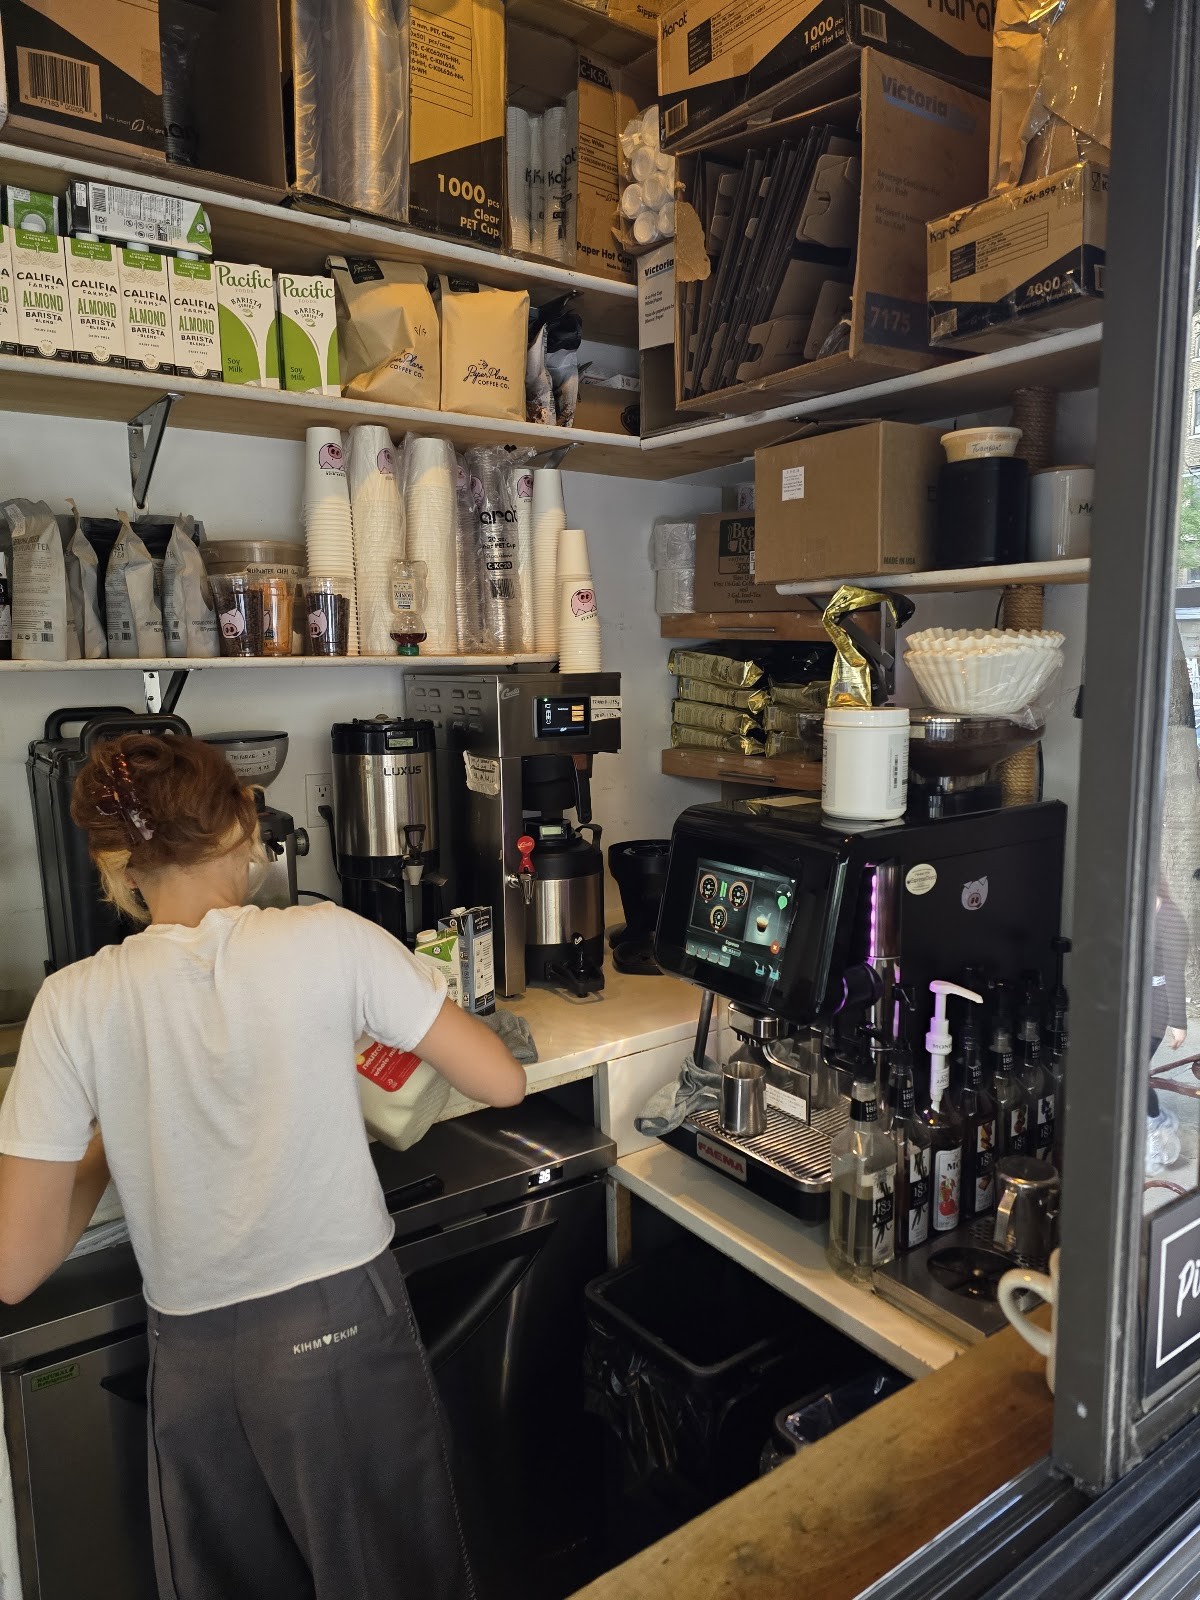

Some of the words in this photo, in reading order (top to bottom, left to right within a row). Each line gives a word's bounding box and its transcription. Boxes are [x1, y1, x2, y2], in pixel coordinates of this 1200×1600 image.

[662, 11, 687, 40] Karat
[804, 16, 833, 45] 1000
[834, 16, 845, 28] pcs
[441, 31, 455, 41] Clear
[809, 41, 822, 54] PET
[822, 35, 834, 47] Flat
[580, 63, 611, 87] C-K50
[881, 73, 948, 118] Victoria
[40, 97, 60, 108] 77183
[64, 103, 84, 115] 00205
[438, 173, 485, 204] 1000
[487, 198, 499, 209] pcs
[474, 208, 499, 225] Clear
[460, 216, 478, 231] PET
[480, 222, 499, 239] Cup
[577, 241, 600, 256] Paper
[601, 248, 615, 261] Hot
[617, 253, 632, 267] Cup
[645, 258, 674, 277] Victoria
[17, 272, 64, 287] CALIFIA
[215, 265, 273, 289] Pacific
[72, 280, 118, 294] CALIFIA
[279, 277, 336, 299] Pacific
[23, 290, 64, 312] ALMOND
[123, 289, 167, 303] CALIFIA
[231, 296, 262, 309] BARISTA
[78, 297, 117, 318] ALMOND
[174, 298, 215, 312] CALIFIA
[294, 307, 324, 319] BARISTA
[26, 311, 63, 322] BARISTA
[80, 318, 117, 329] BARISTA
[129, 307, 166, 327] ALMOND
[871, 305, 911, 336] 7175
[131, 326, 165, 337] BARISTA
[179, 316, 214, 335] ALMOND
[181, 334, 214, 344] BARISTA
[227, 358, 240, 366] Soy
[228, 365, 243, 374] Milk
[291, 367, 303, 375] Soy
[291, 374, 305, 382] Milk
[389, 363, 412, 375] COFFEE
[413, 371, 424, 379] CO.
[463, 365, 488, 384] Paper
[488, 367, 509, 381] Plane
[477, 379, 499, 388] COFFEE
[480, 505, 518, 524] arat
[37, 543, 50, 551] TEA
[884, 557, 898, 565] MADE
[905, 557, 916, 565] USA
[384, 766, 422, 776] LUXUS
[374, 1057, 390, 1077] whole
[698, 1141, 745, 1174] FAEMA
[538, 1168, 551, 1184] 36
[293, 1338, 322, 1355] KIHM
[333, 1325, 358, 1343] EKIM
